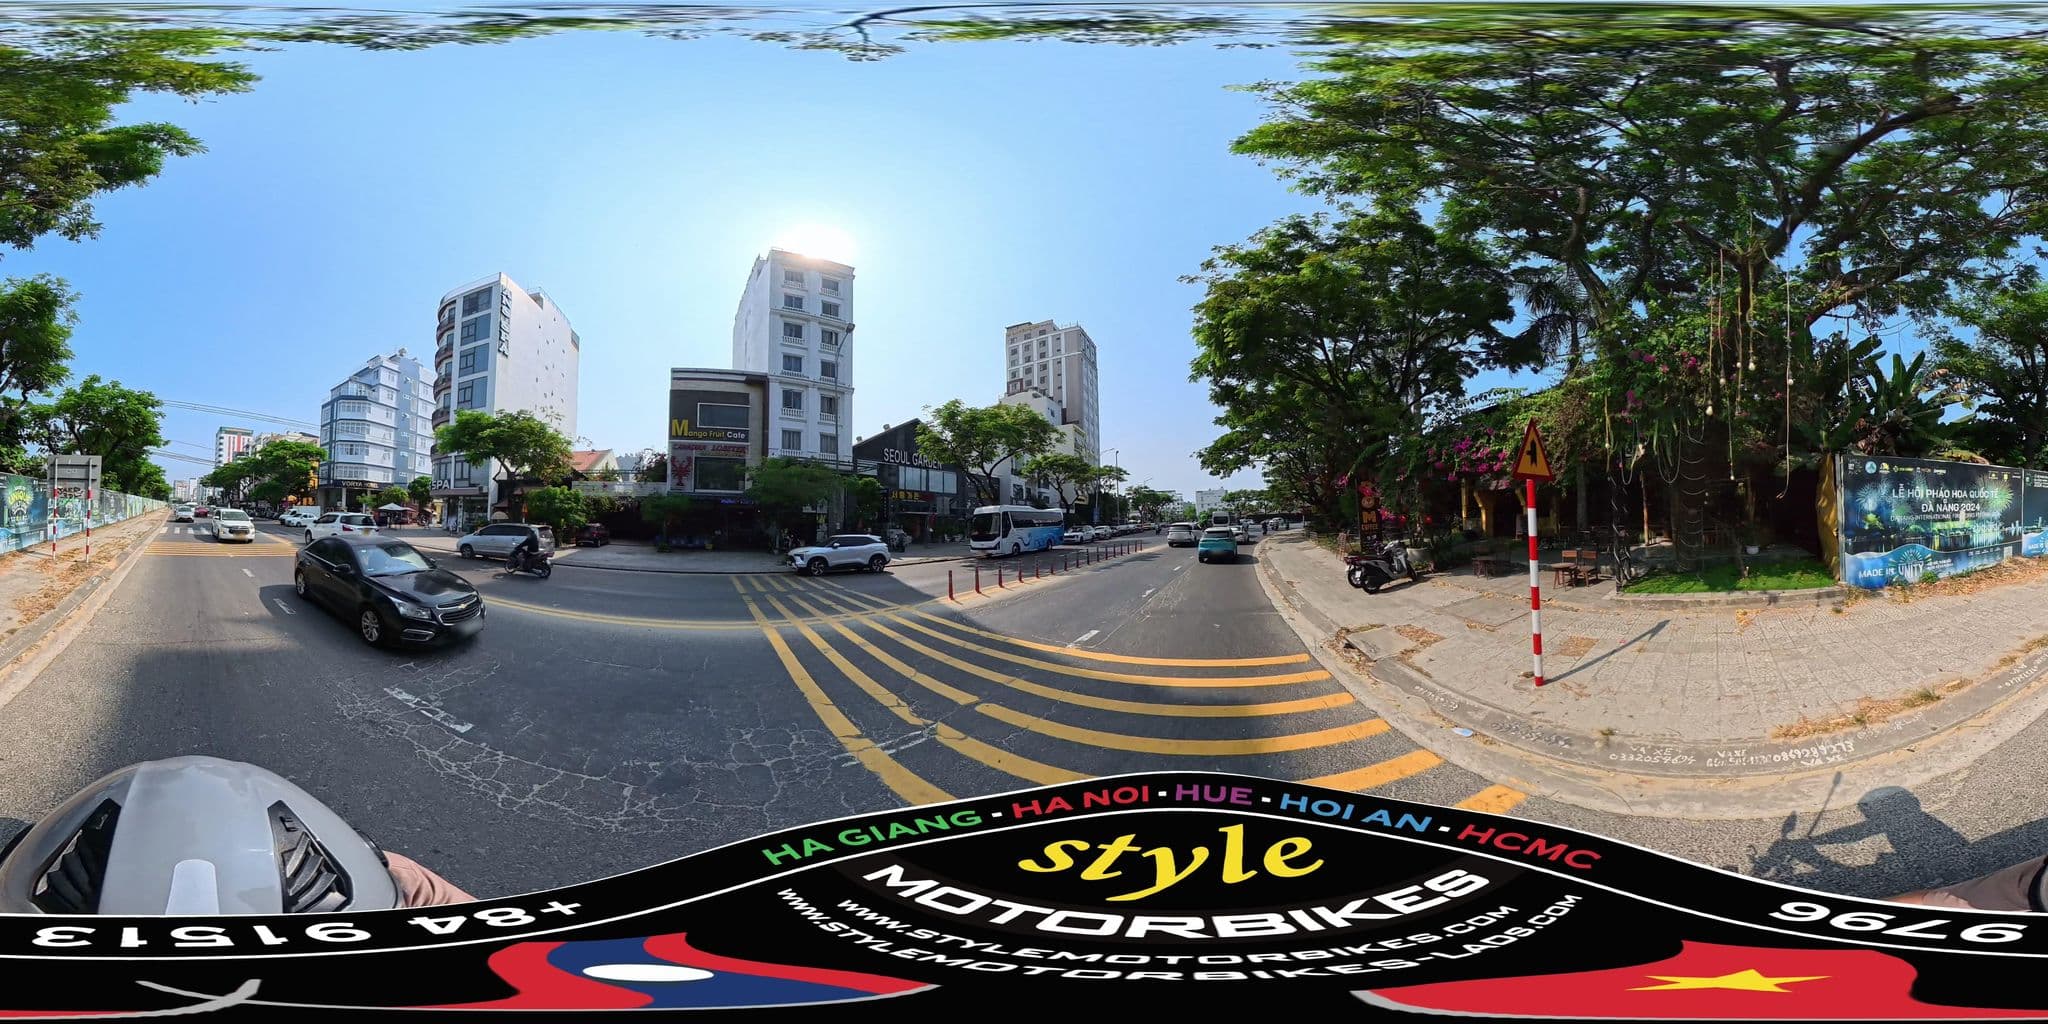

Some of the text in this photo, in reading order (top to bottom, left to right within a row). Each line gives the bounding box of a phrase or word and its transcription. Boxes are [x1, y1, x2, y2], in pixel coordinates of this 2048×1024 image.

[672, 418, 746, 439] Mango Fruit Cafe
[883, 448, 910, 465] SEOUL
[431, 480, 450, 490] SPA
[1926, 488, 1950, 499] PHÁO
[1951, 490, 1968, 498] HOA
[1922, 500, 1934, 512] ĐÀ
[1961, 503, 1980, 512] 2024
[1859, 569, 1884, 578] MADE
[1898, 561, 1924, 580] UNITY
